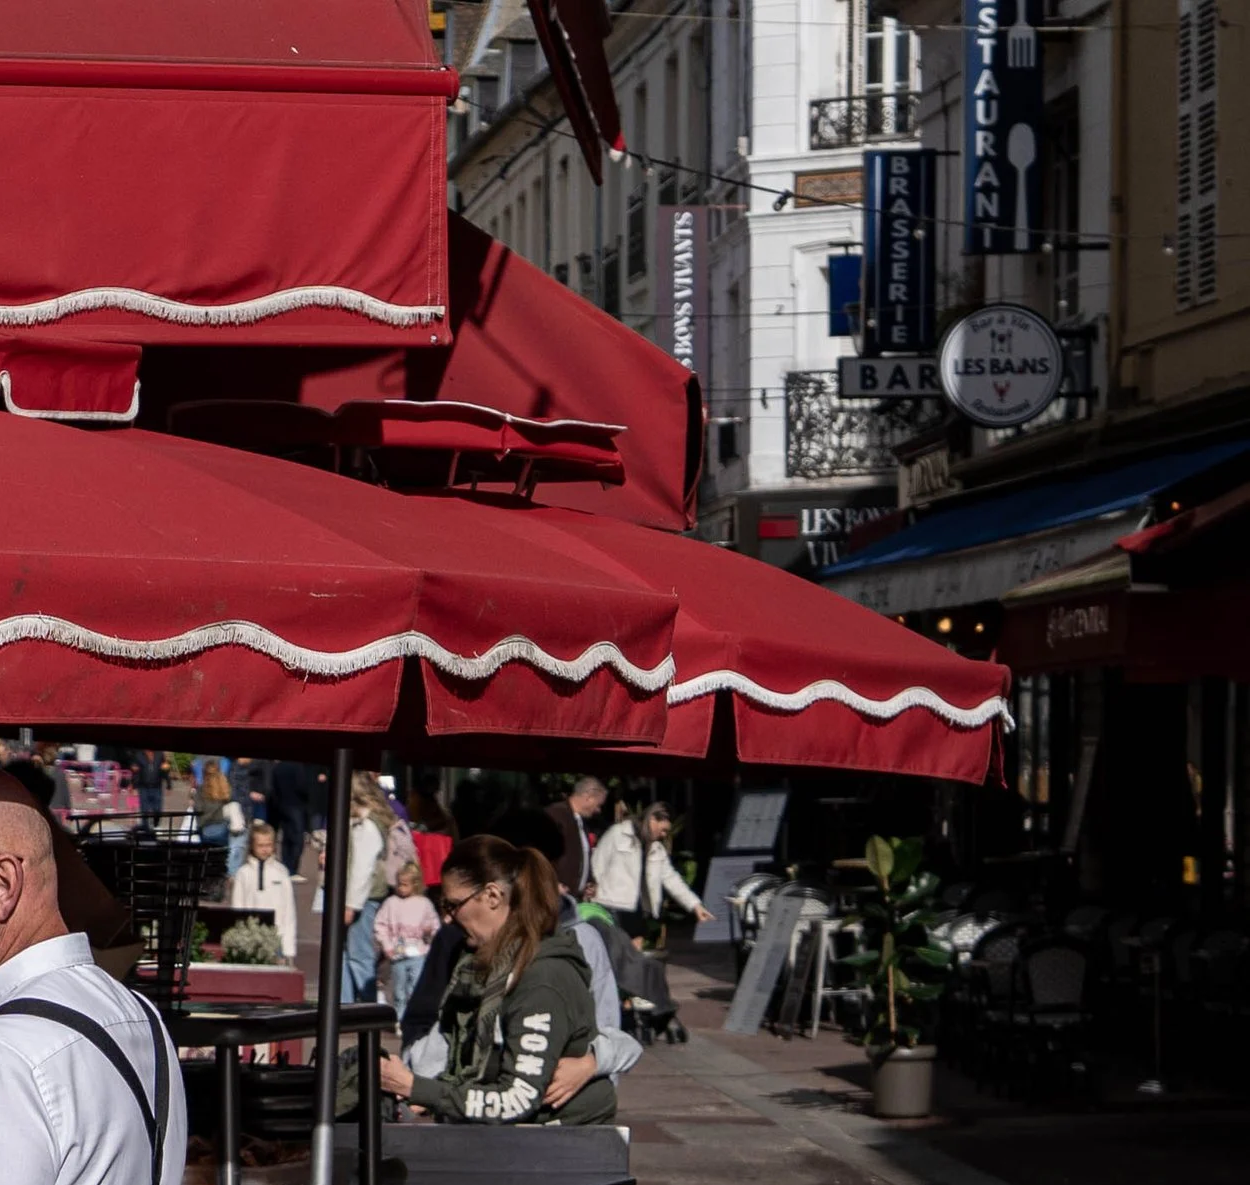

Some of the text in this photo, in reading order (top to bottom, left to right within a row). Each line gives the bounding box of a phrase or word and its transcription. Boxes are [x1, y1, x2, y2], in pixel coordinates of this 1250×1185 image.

[973, 0, 1000, 249] STAURANT
[673, 211, 694, 300] VIVANTS
[888, 155, 912, 345] BRASSERIE
[859, 363, 941, 391] BAR
[954, 358, 985, 375] LES
[801, 508, 842, 536] LES
